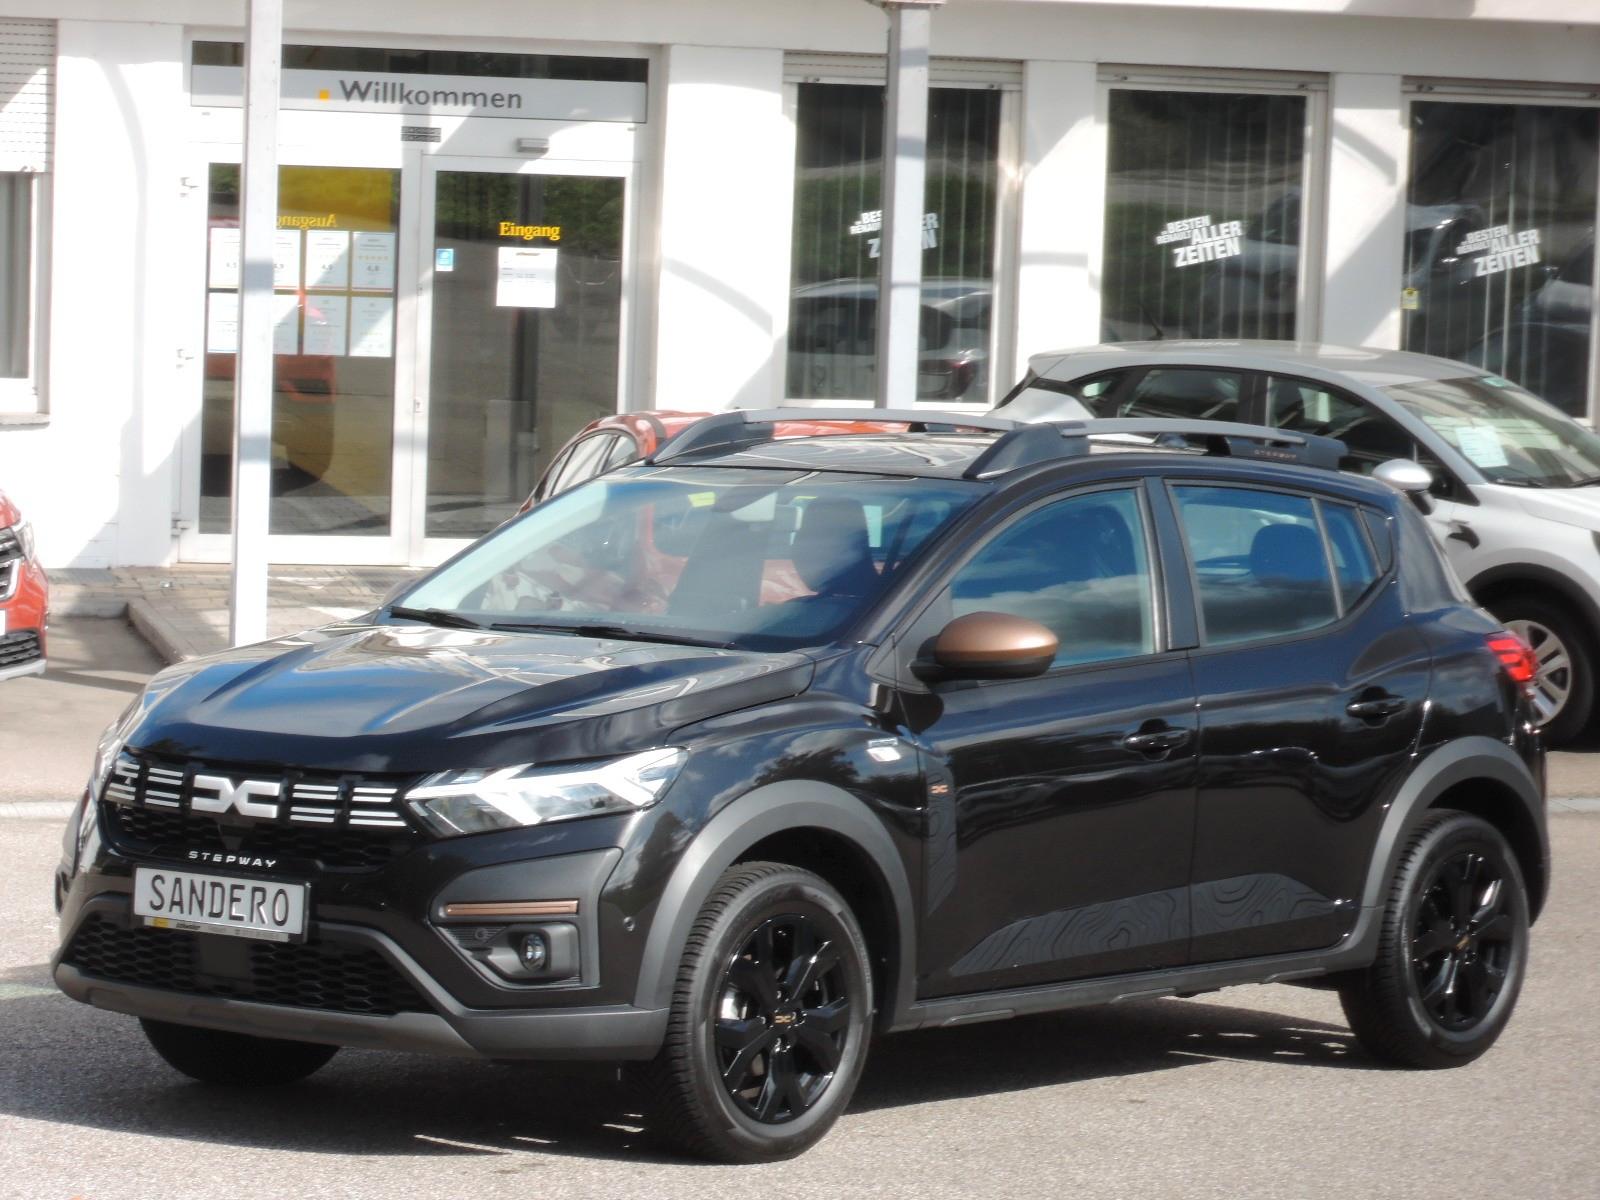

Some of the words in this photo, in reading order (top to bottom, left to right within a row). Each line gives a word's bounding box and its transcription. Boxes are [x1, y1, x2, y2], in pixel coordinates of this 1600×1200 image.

[339, 80, 522, 109] Willkommen
[861, 210, 883, 224] BES
[1166, 214, 1211, 233] BESTEN
[499, 222, 560, 240] Eingang
[1191, 220, 1243, 246] ALLER
[1466, 224, 1509, 242] BESTEN
[1490, 229, 1540, 254] ALLER
[1173, 236, 1241, 268] ZEITEN
[1473, 244, 1541, 277] ZEITEN
[188, 850, 277, 868] STEPWAY
[149, 874, 289, 927] SANDERO
